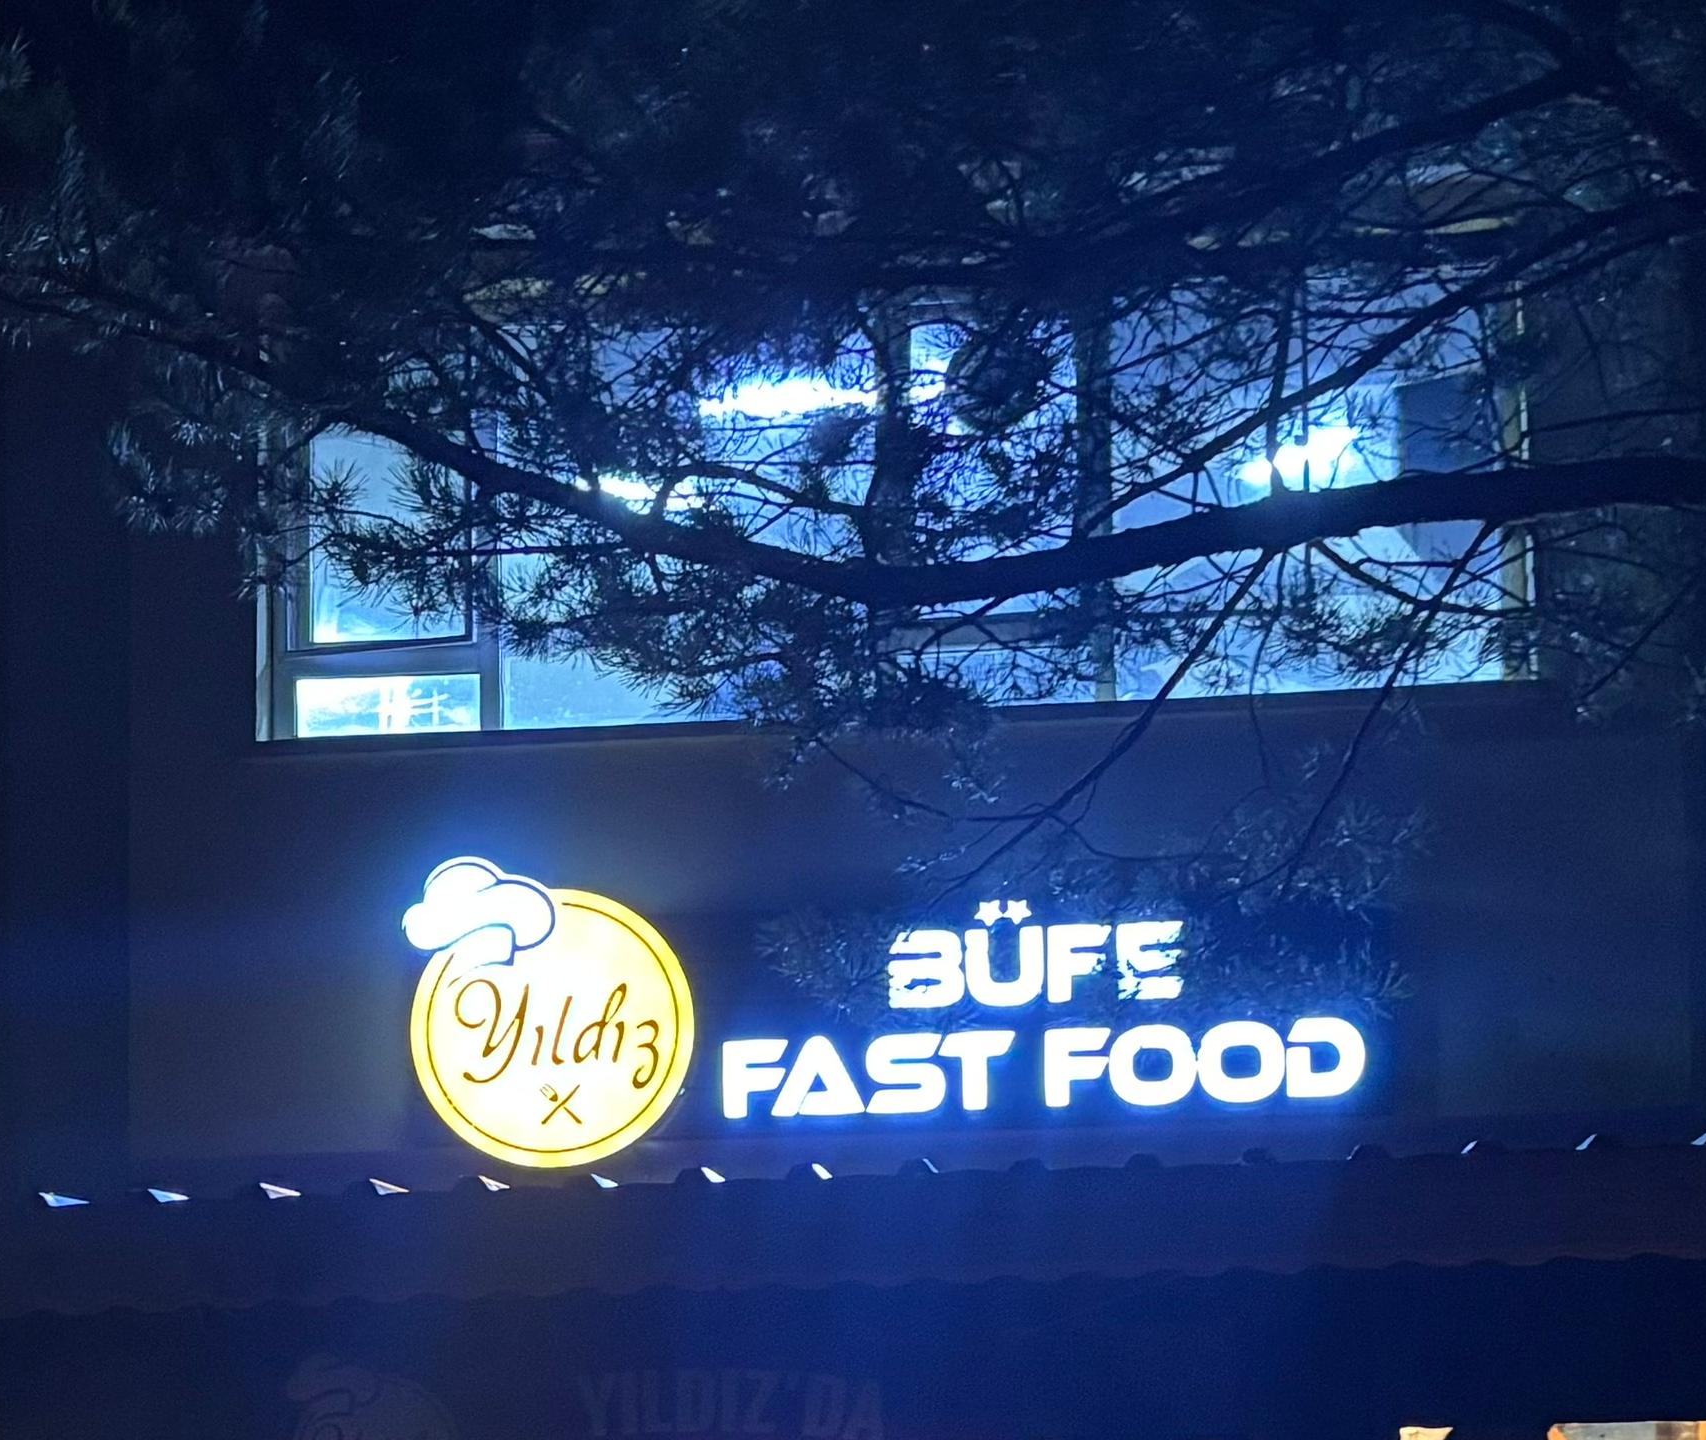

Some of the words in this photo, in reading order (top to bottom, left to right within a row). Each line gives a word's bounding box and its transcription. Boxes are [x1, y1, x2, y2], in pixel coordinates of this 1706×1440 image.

[888, 900, 1183, 1008] BÜFE
[455, 978, 659, 1089] Yıldız
[721, 1030, 1015, 1119] FAST
[1043, 1016, 1366, 1107] FOOD
